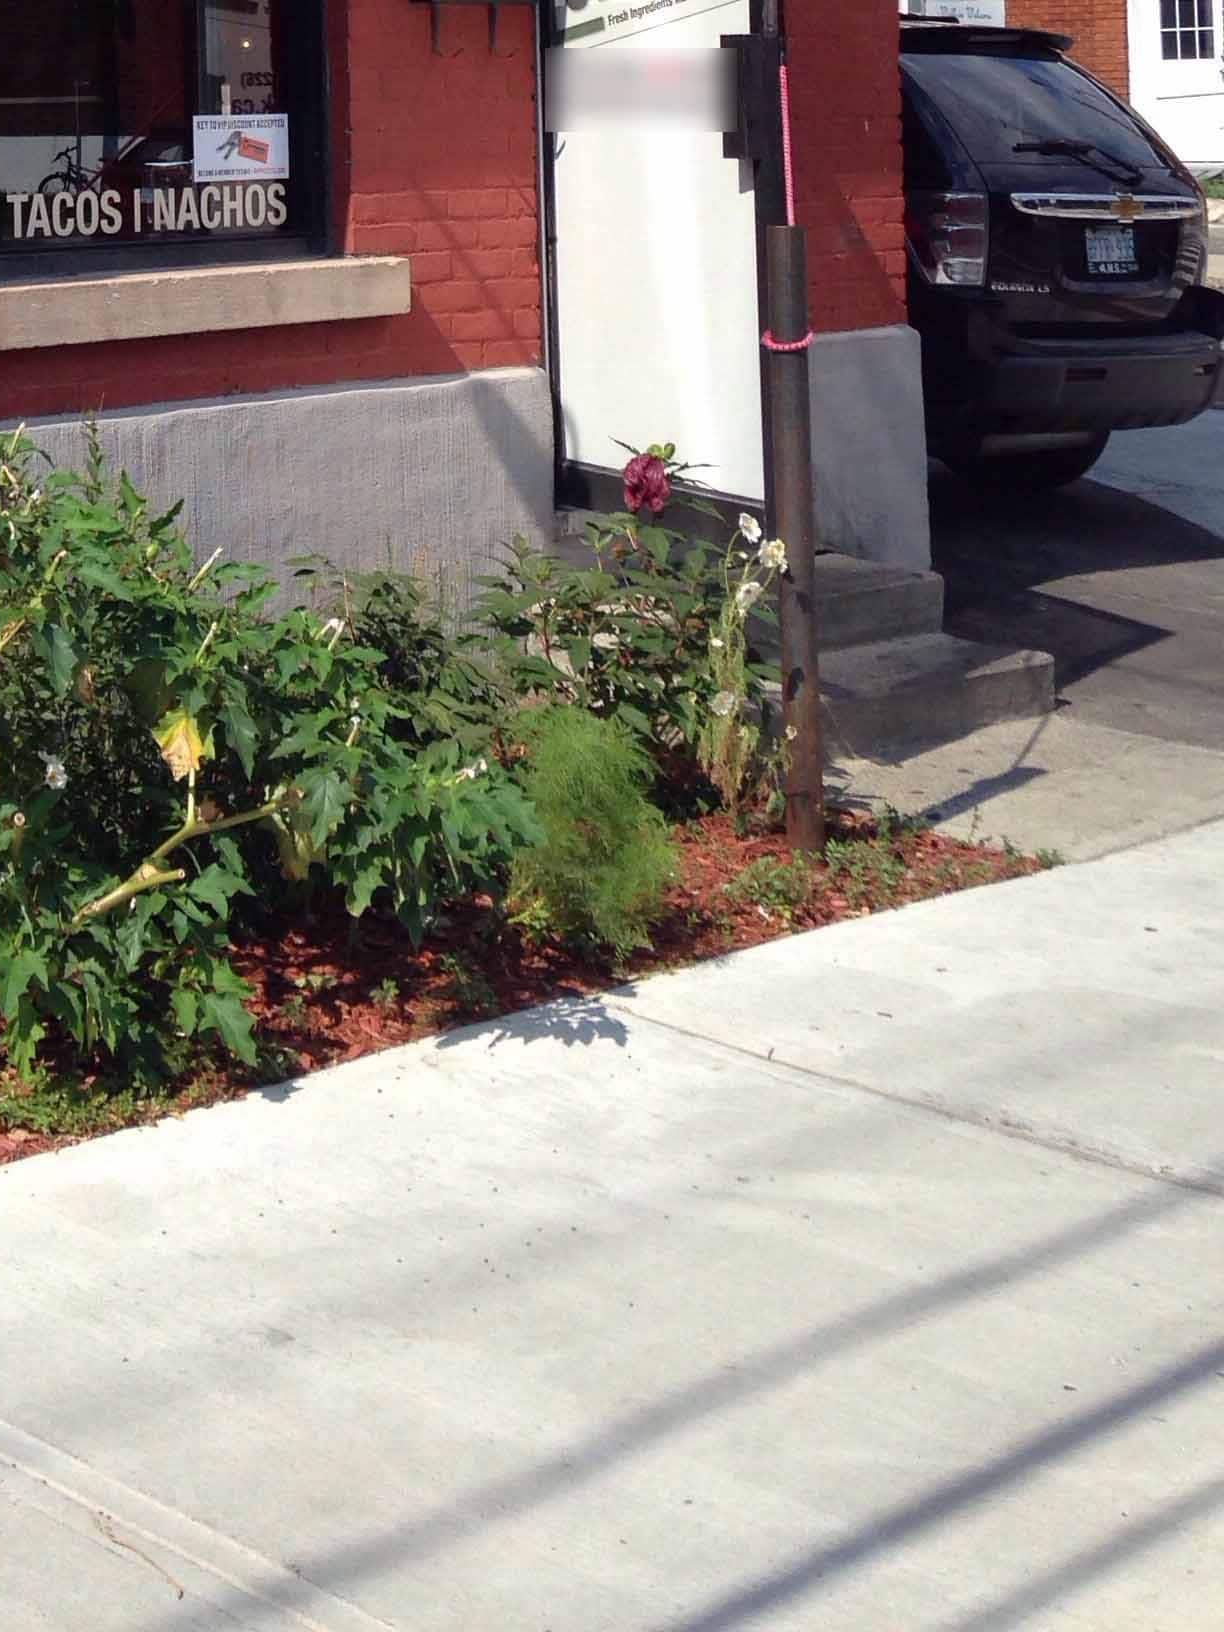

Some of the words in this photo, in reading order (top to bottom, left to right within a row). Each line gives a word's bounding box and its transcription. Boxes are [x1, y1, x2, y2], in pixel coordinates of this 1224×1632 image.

[608, 11, 627, 26] Fresh
[7, 190, 123, 240] TACOS
[152, 183, 287, 232] NACHOS
